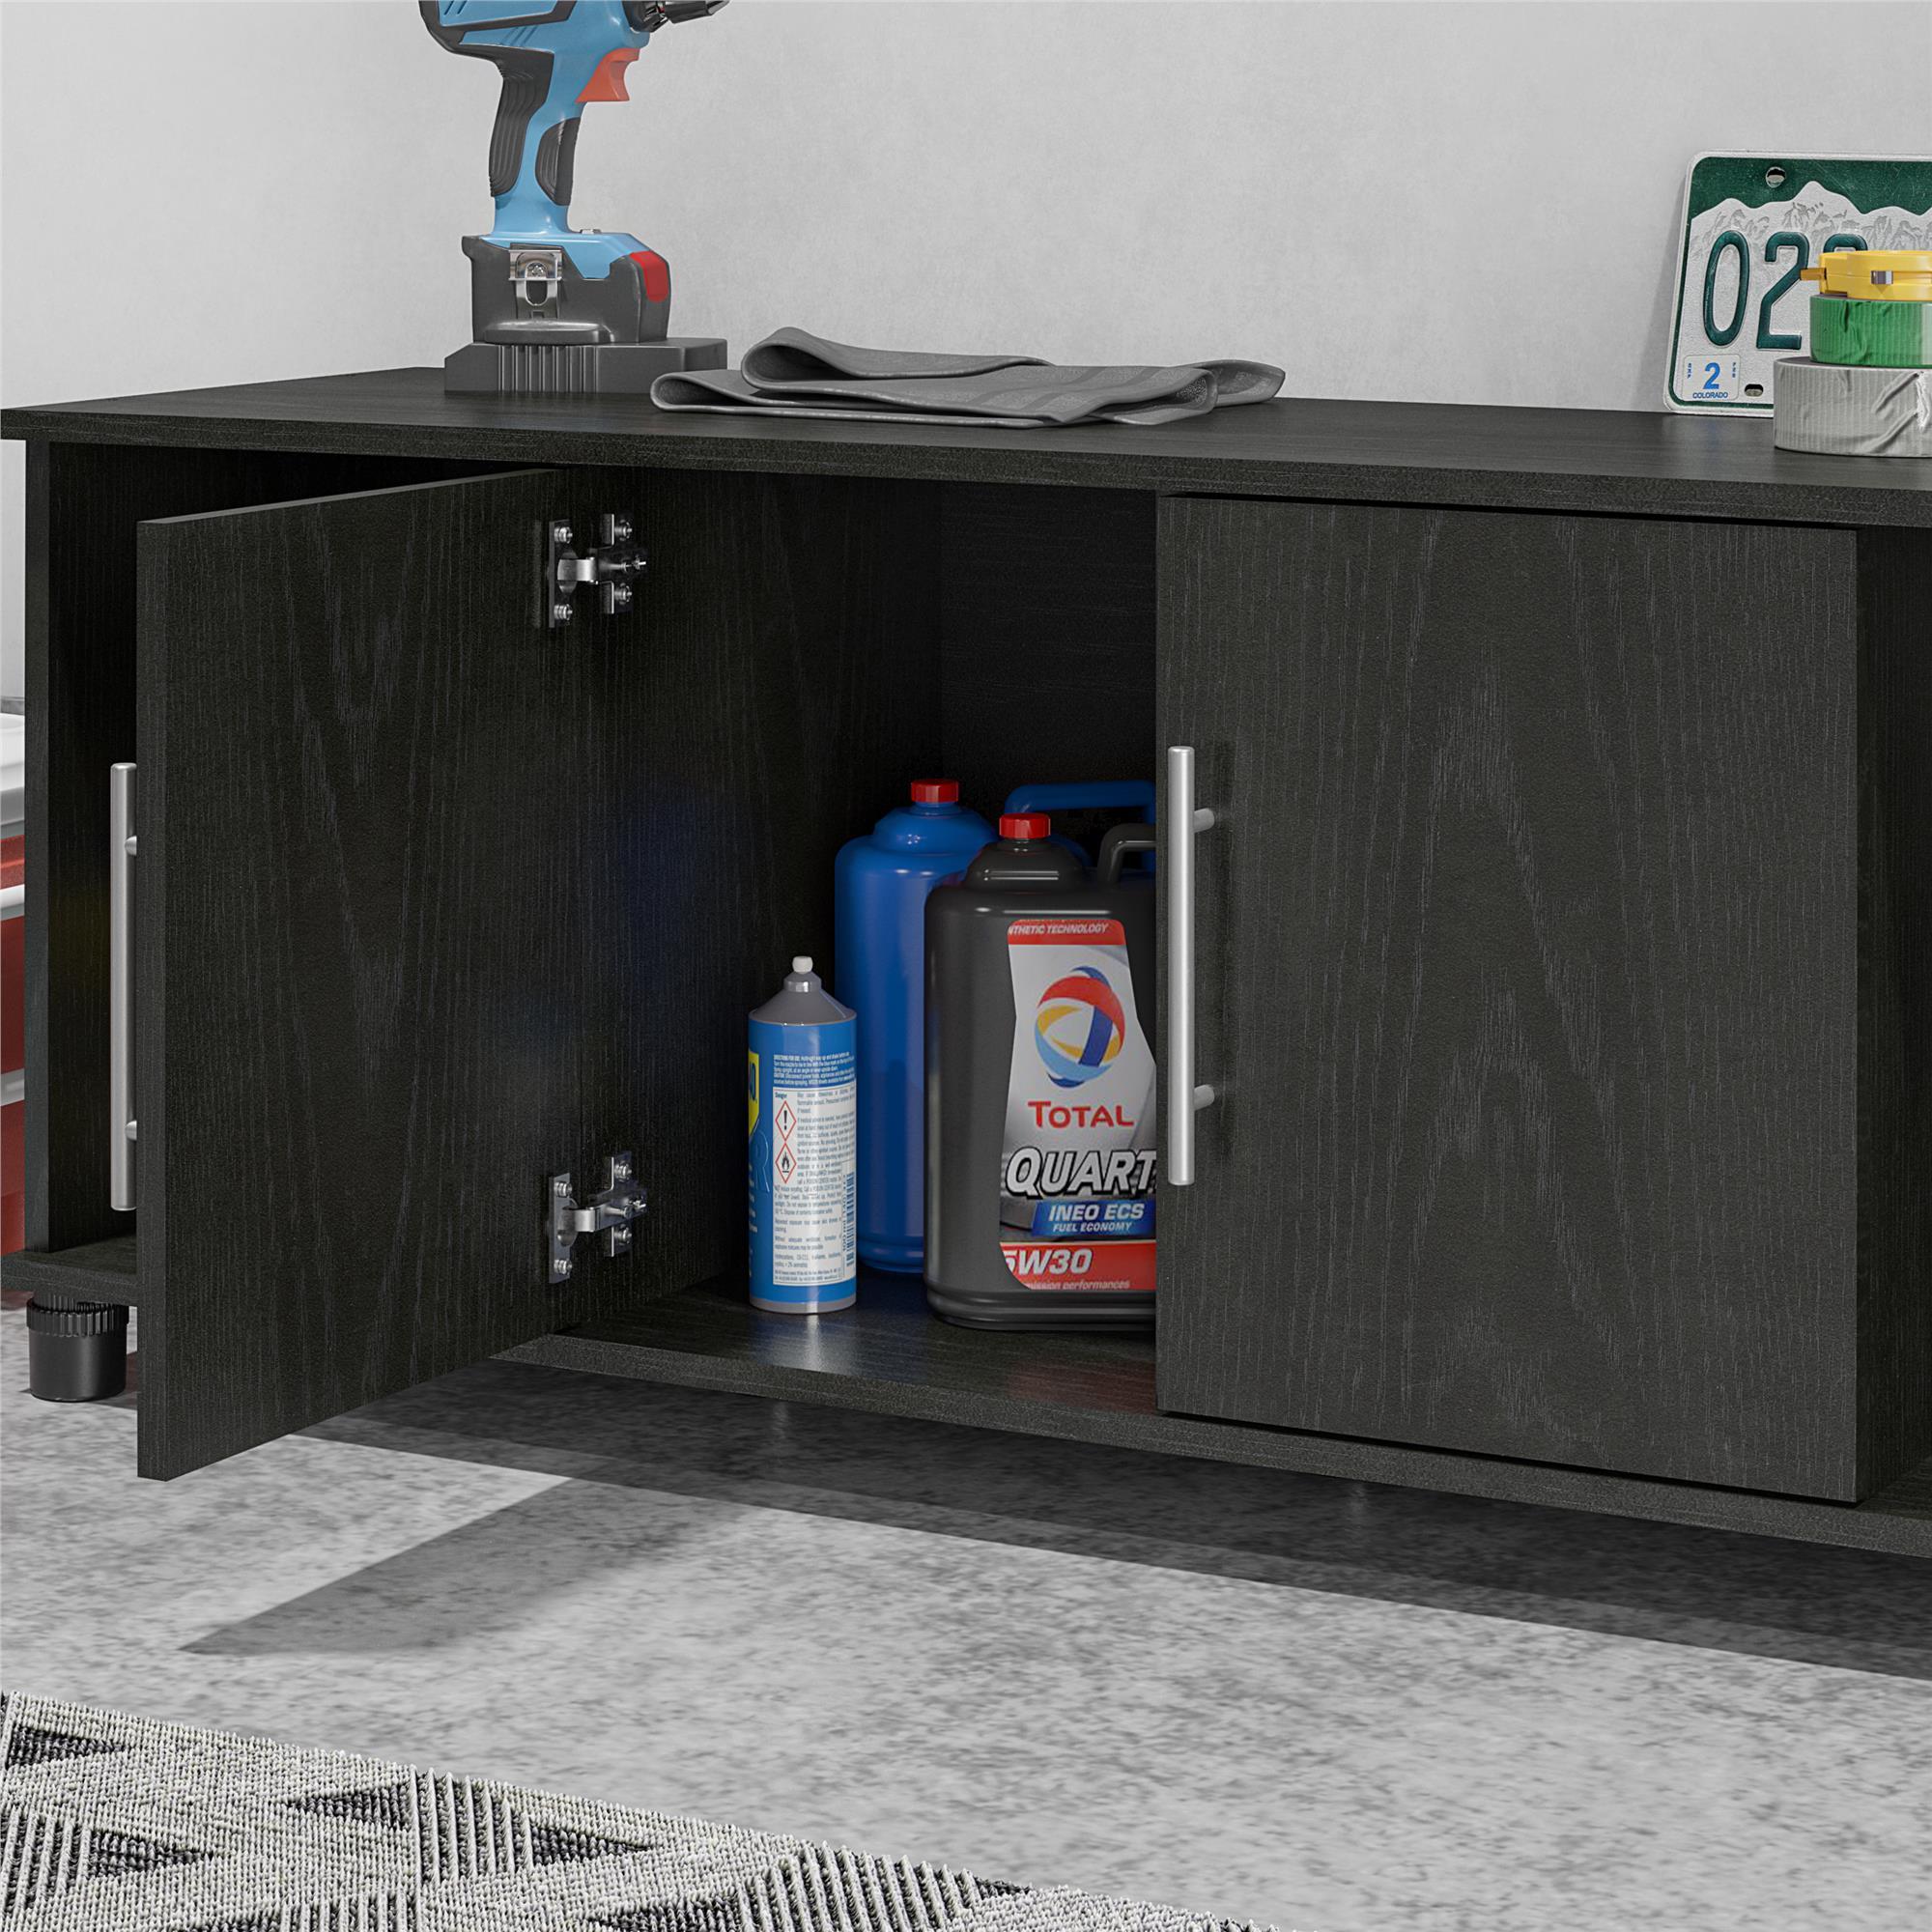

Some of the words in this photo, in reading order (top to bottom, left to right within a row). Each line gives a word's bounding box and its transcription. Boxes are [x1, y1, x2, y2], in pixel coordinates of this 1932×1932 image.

[1703, 229, 1868, 350] 02
[1702, 362, 1720, 390] 2
[1046, 923, 1109, 934] TECHNOLOGY
[1006, 1146, 1156, 1200] QUART
[1048, 1205, 1100, 1221] INEO
[1104, 1203, 1145, 1220] ECS
[1053, 1222, 1078, 1233] FUEL
[1080, 1221, 1132, 1233] ECONOMY
[1062, 1280, 1130, 1291] performances
